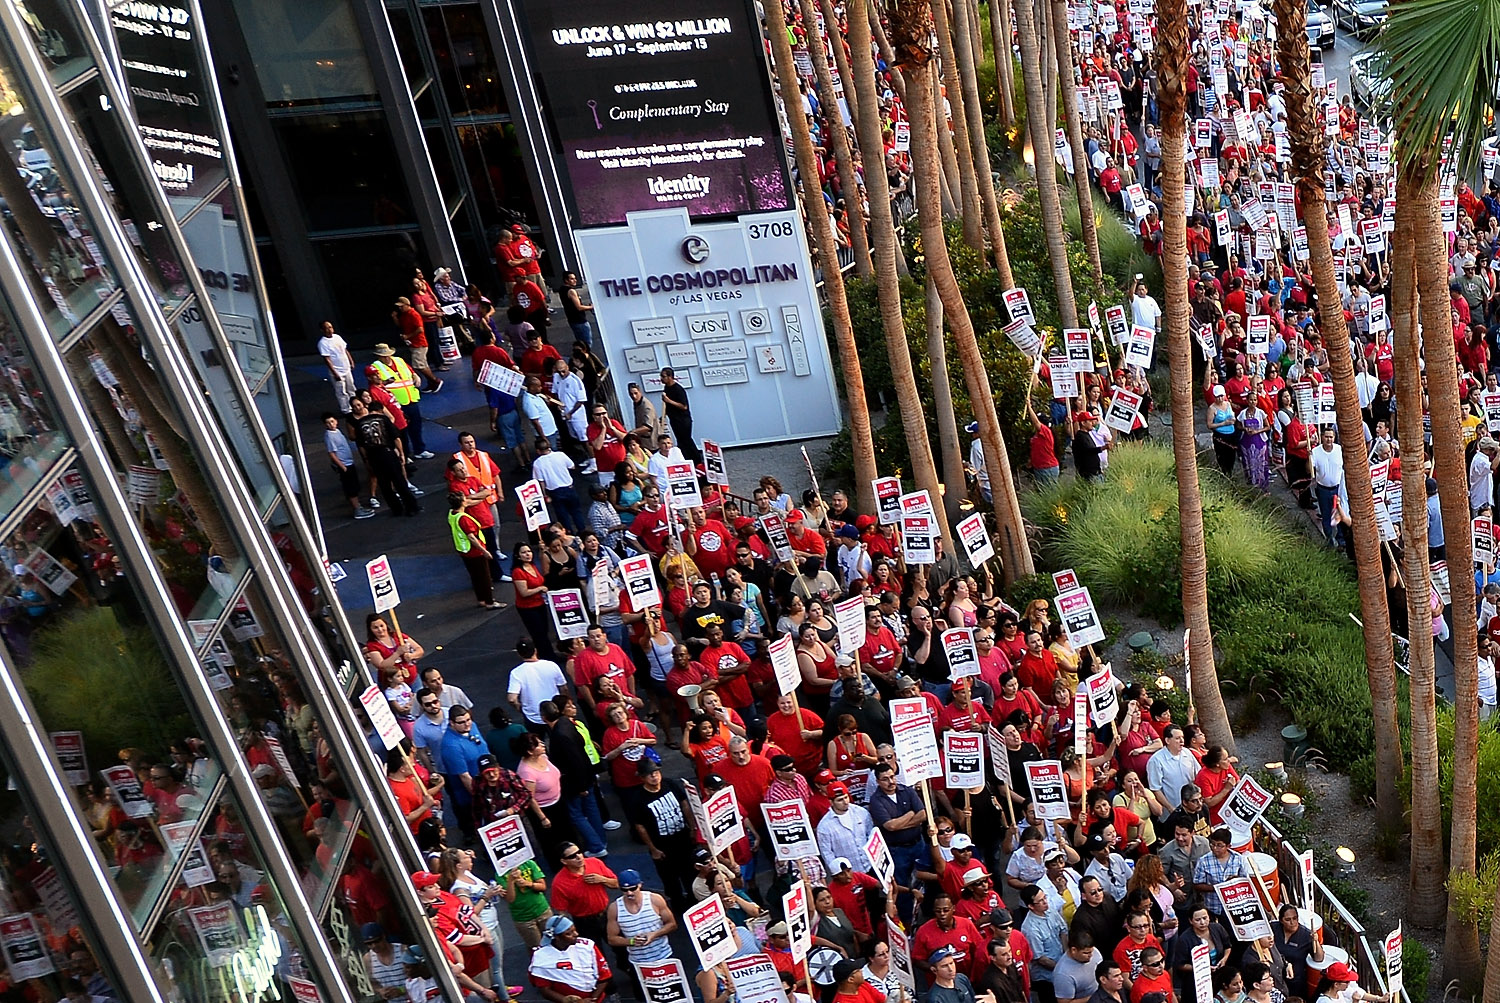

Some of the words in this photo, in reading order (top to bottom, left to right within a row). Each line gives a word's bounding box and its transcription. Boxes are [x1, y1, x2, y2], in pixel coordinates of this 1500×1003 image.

[552, 25, 613, 44] UNLOCK
[612, 24, 626, 41] &
[624, 22, 656, 40] WIN
[655, 20, 676, 39] $2
[674, 17, 732, 37] MILLION
[586, 45, 613, 57] June
[613, 43, 627, 55] 17
[636, 39, 693, 55] September
[694, 37, 708, 50] 15
[609, 104, 701, 121] Complementary
[704, 99, 729, 115] Stay
[597, 147, 636, 158] members
[637, 144, 666, 155] receive
[667, 144, 683, 152] one
[683, 138, 745, 151] complementary
[600, 158, 621, 169] Visit
[651, 152, 702, 165] Membership
[702, 150, 715, 161] for
[715, 149, 746, 160] details.
[647, 174, 710, 195] Identity
[749, 222, 793, 240] 3708
[600, 278, 642, 298] THE
[646, 263, 799, 296] COSMOPOLITAN
[669, 296, 680, 306] of
[683, 294, 703, 304] LAS
[706, 290, 743, 302] VEGAS
[703, 367, 746, 377] MARQUEE
[1225, 889, 1236, 897] No
[1226, 893, 1253, 904] Justicia
[1232, 908, 1243, 916] No
[1240, 914, 1254, 922] Paz
[732, 964, 774, 979] UNFAIR
